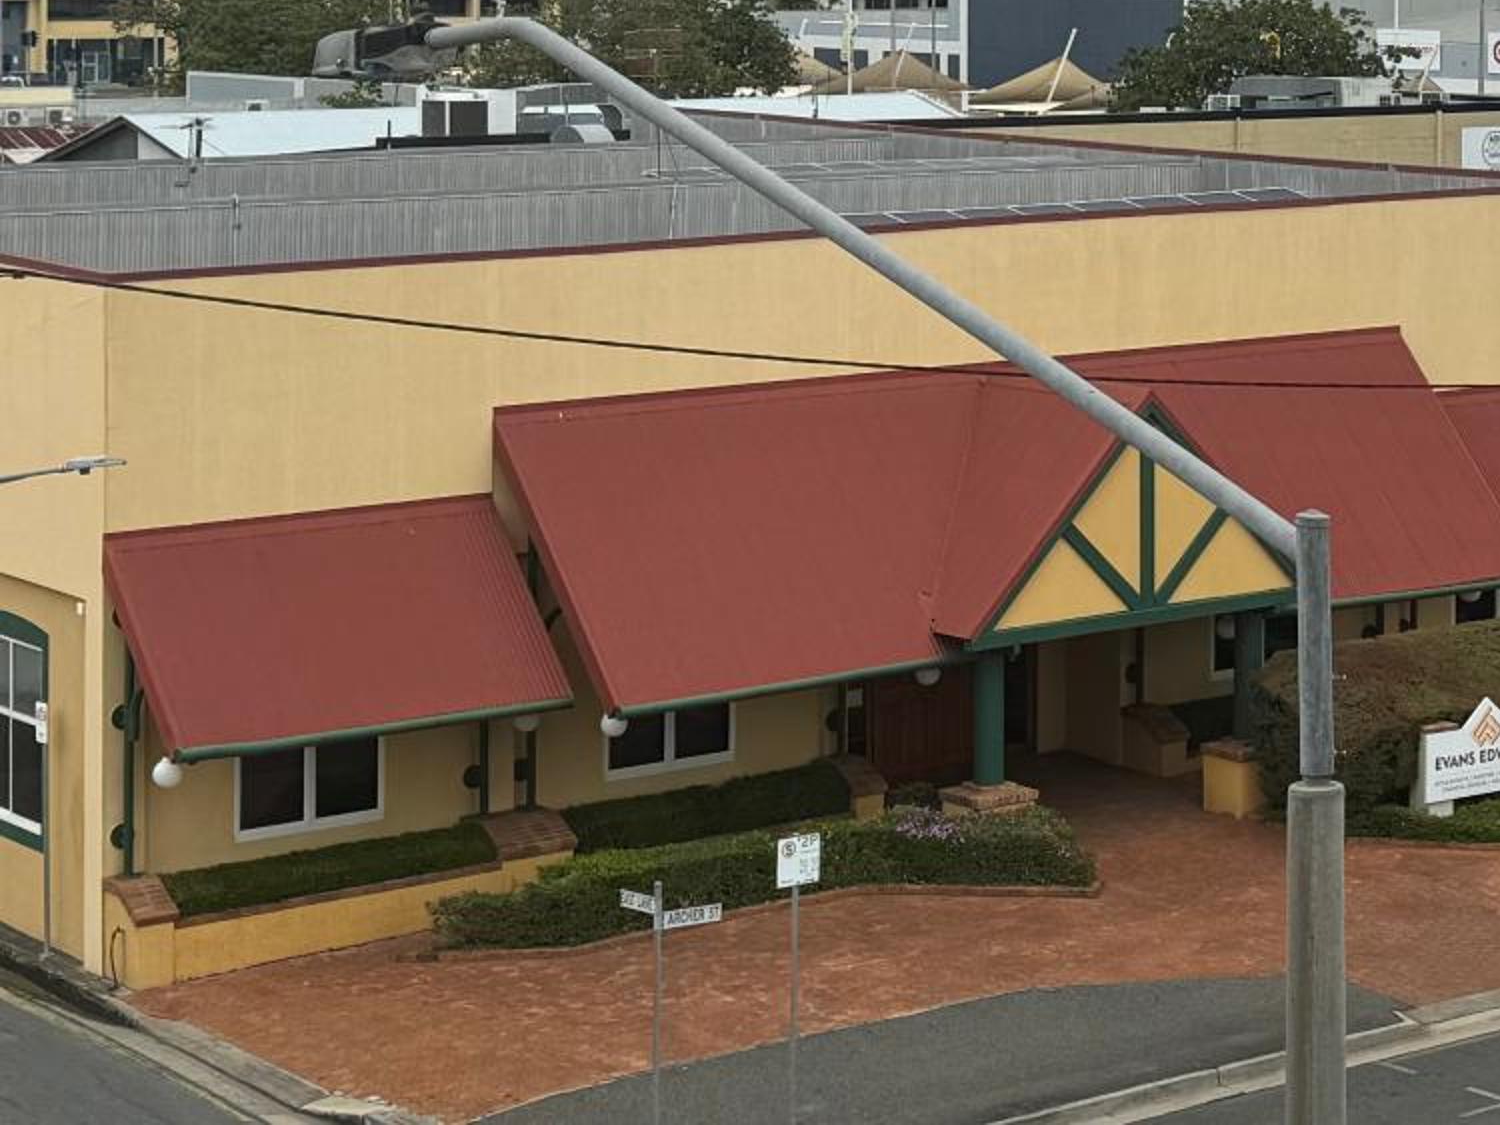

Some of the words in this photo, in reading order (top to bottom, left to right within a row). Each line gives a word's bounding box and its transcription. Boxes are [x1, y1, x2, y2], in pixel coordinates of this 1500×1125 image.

[1435, 751, 1476, 772] EVANS
[668, 906, 706, 925] ARCHER
[707, 905, 720, 921] ST
